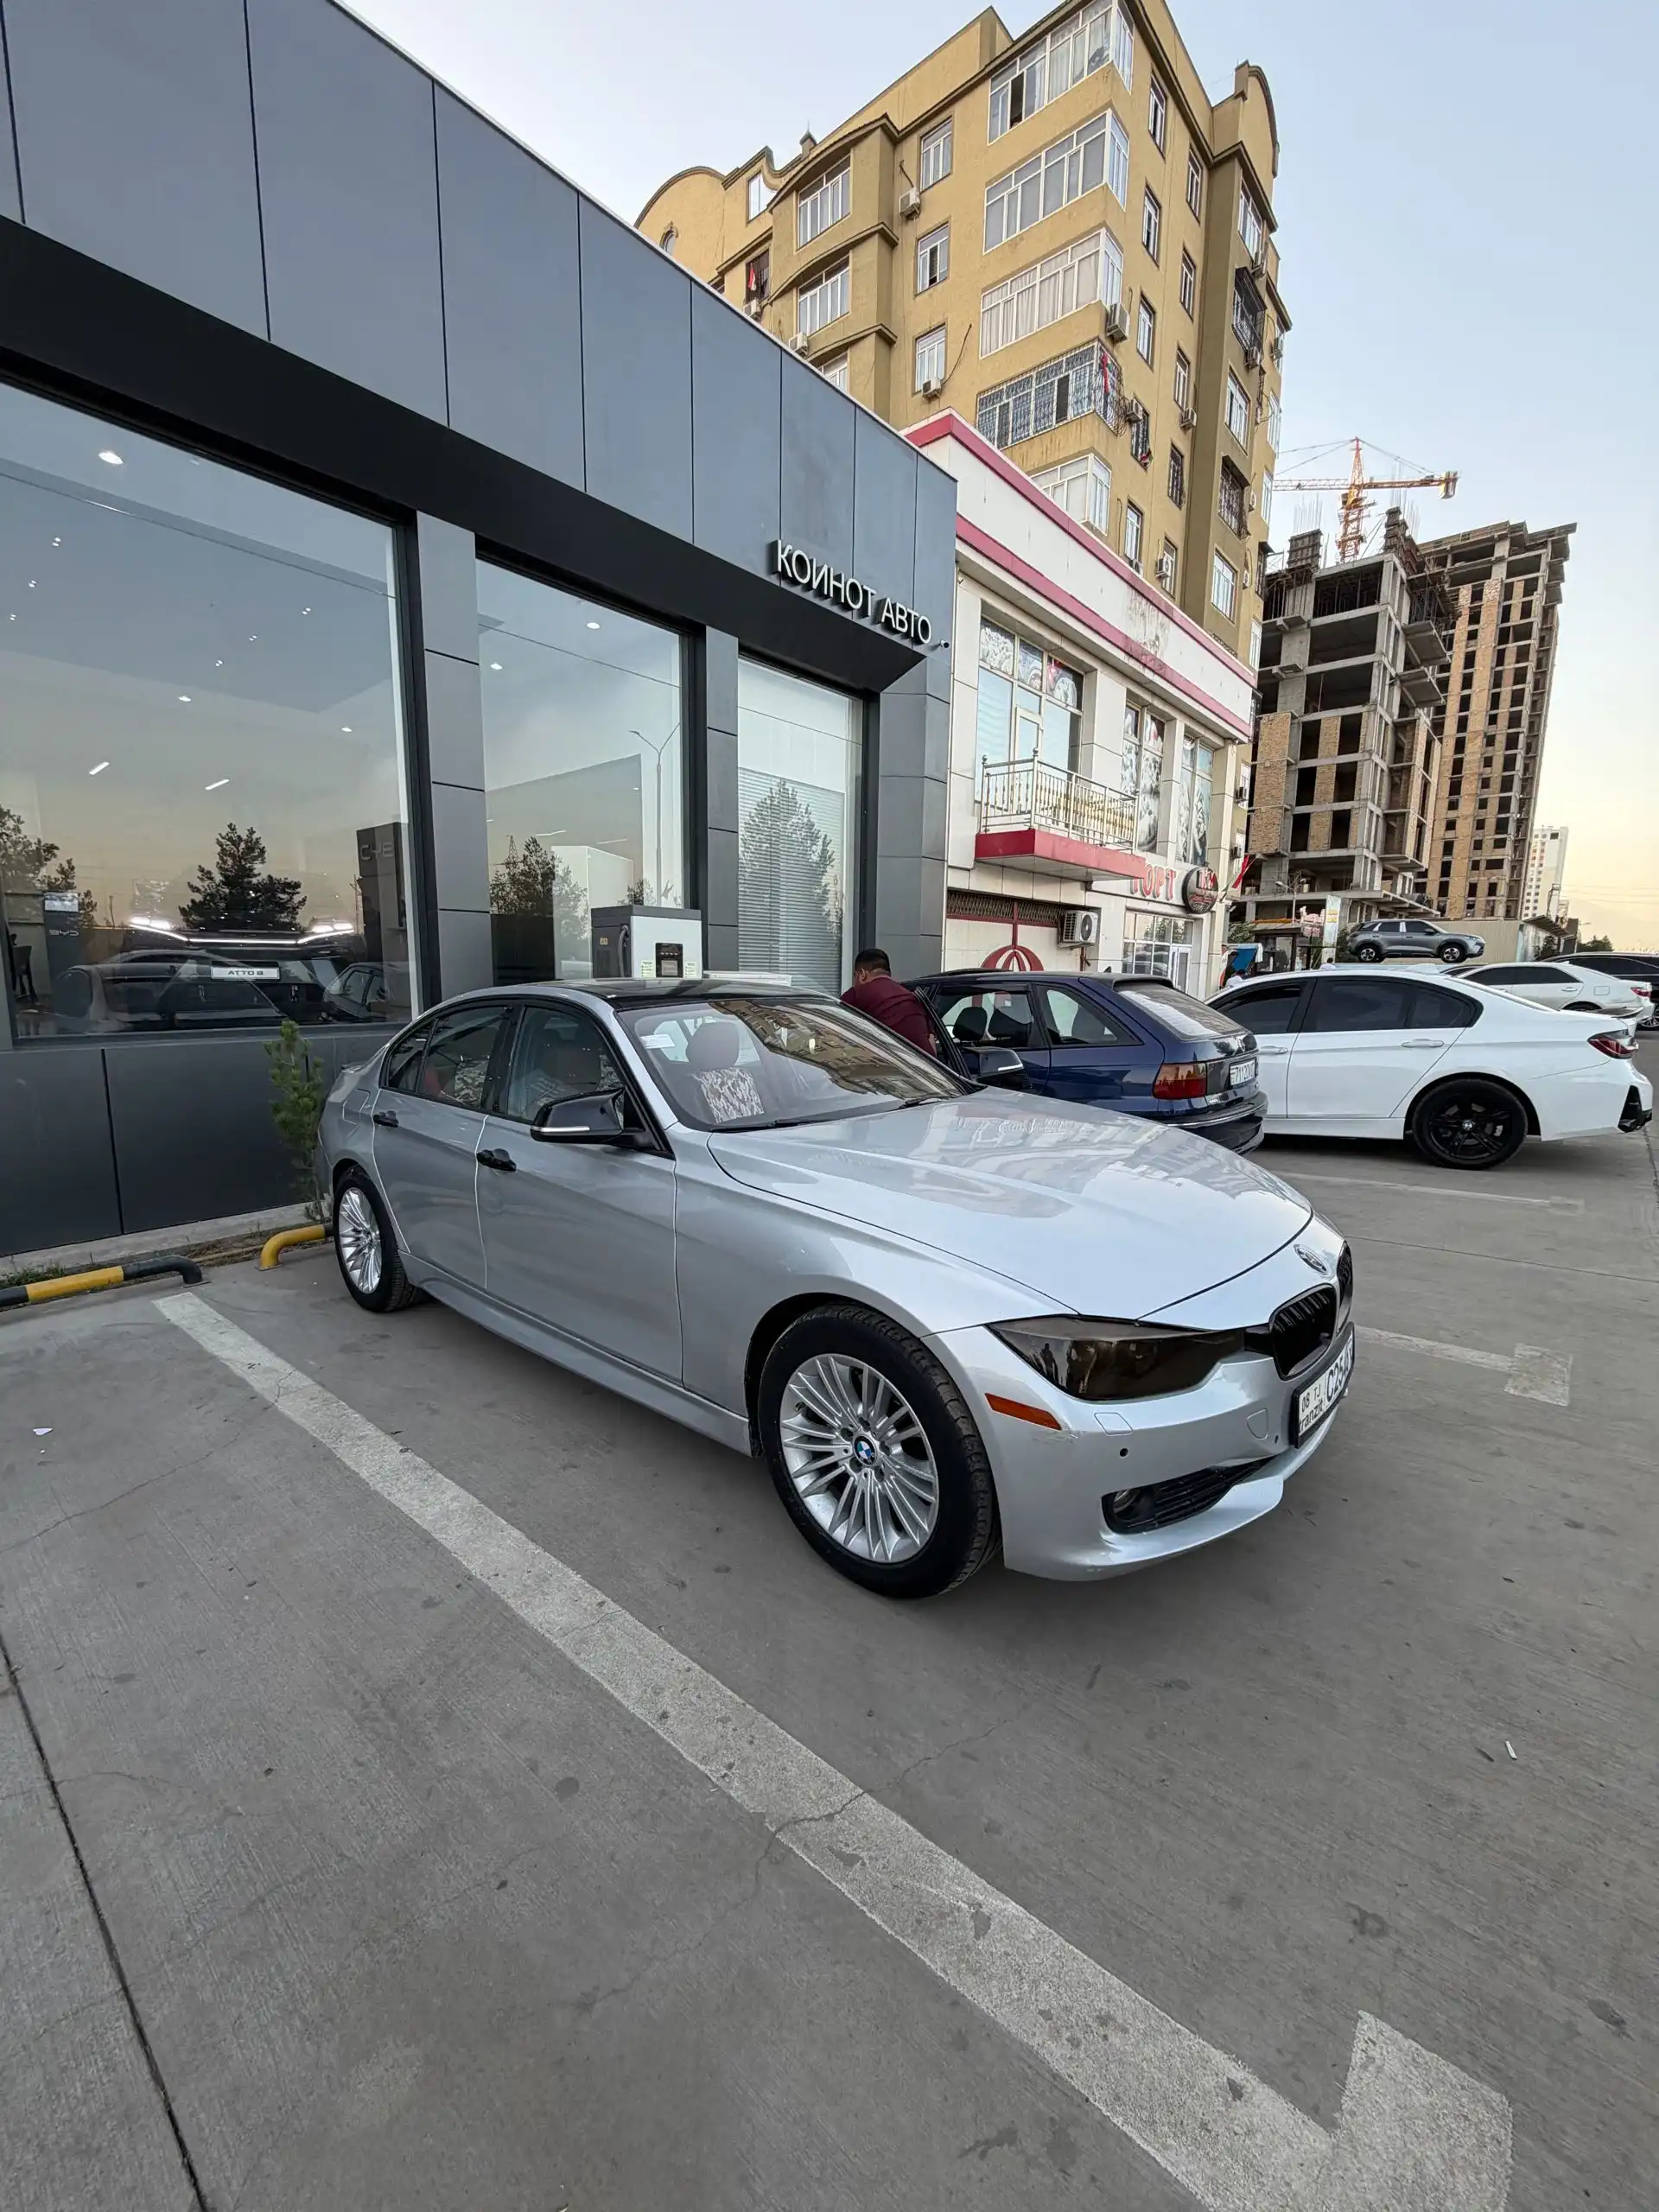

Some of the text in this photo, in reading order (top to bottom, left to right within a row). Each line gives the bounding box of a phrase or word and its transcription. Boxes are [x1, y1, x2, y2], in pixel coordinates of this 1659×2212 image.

[776, 539, 932, 645] КОИНОТ АВТО
[1313, 1383, 1321, 1402] TJ
